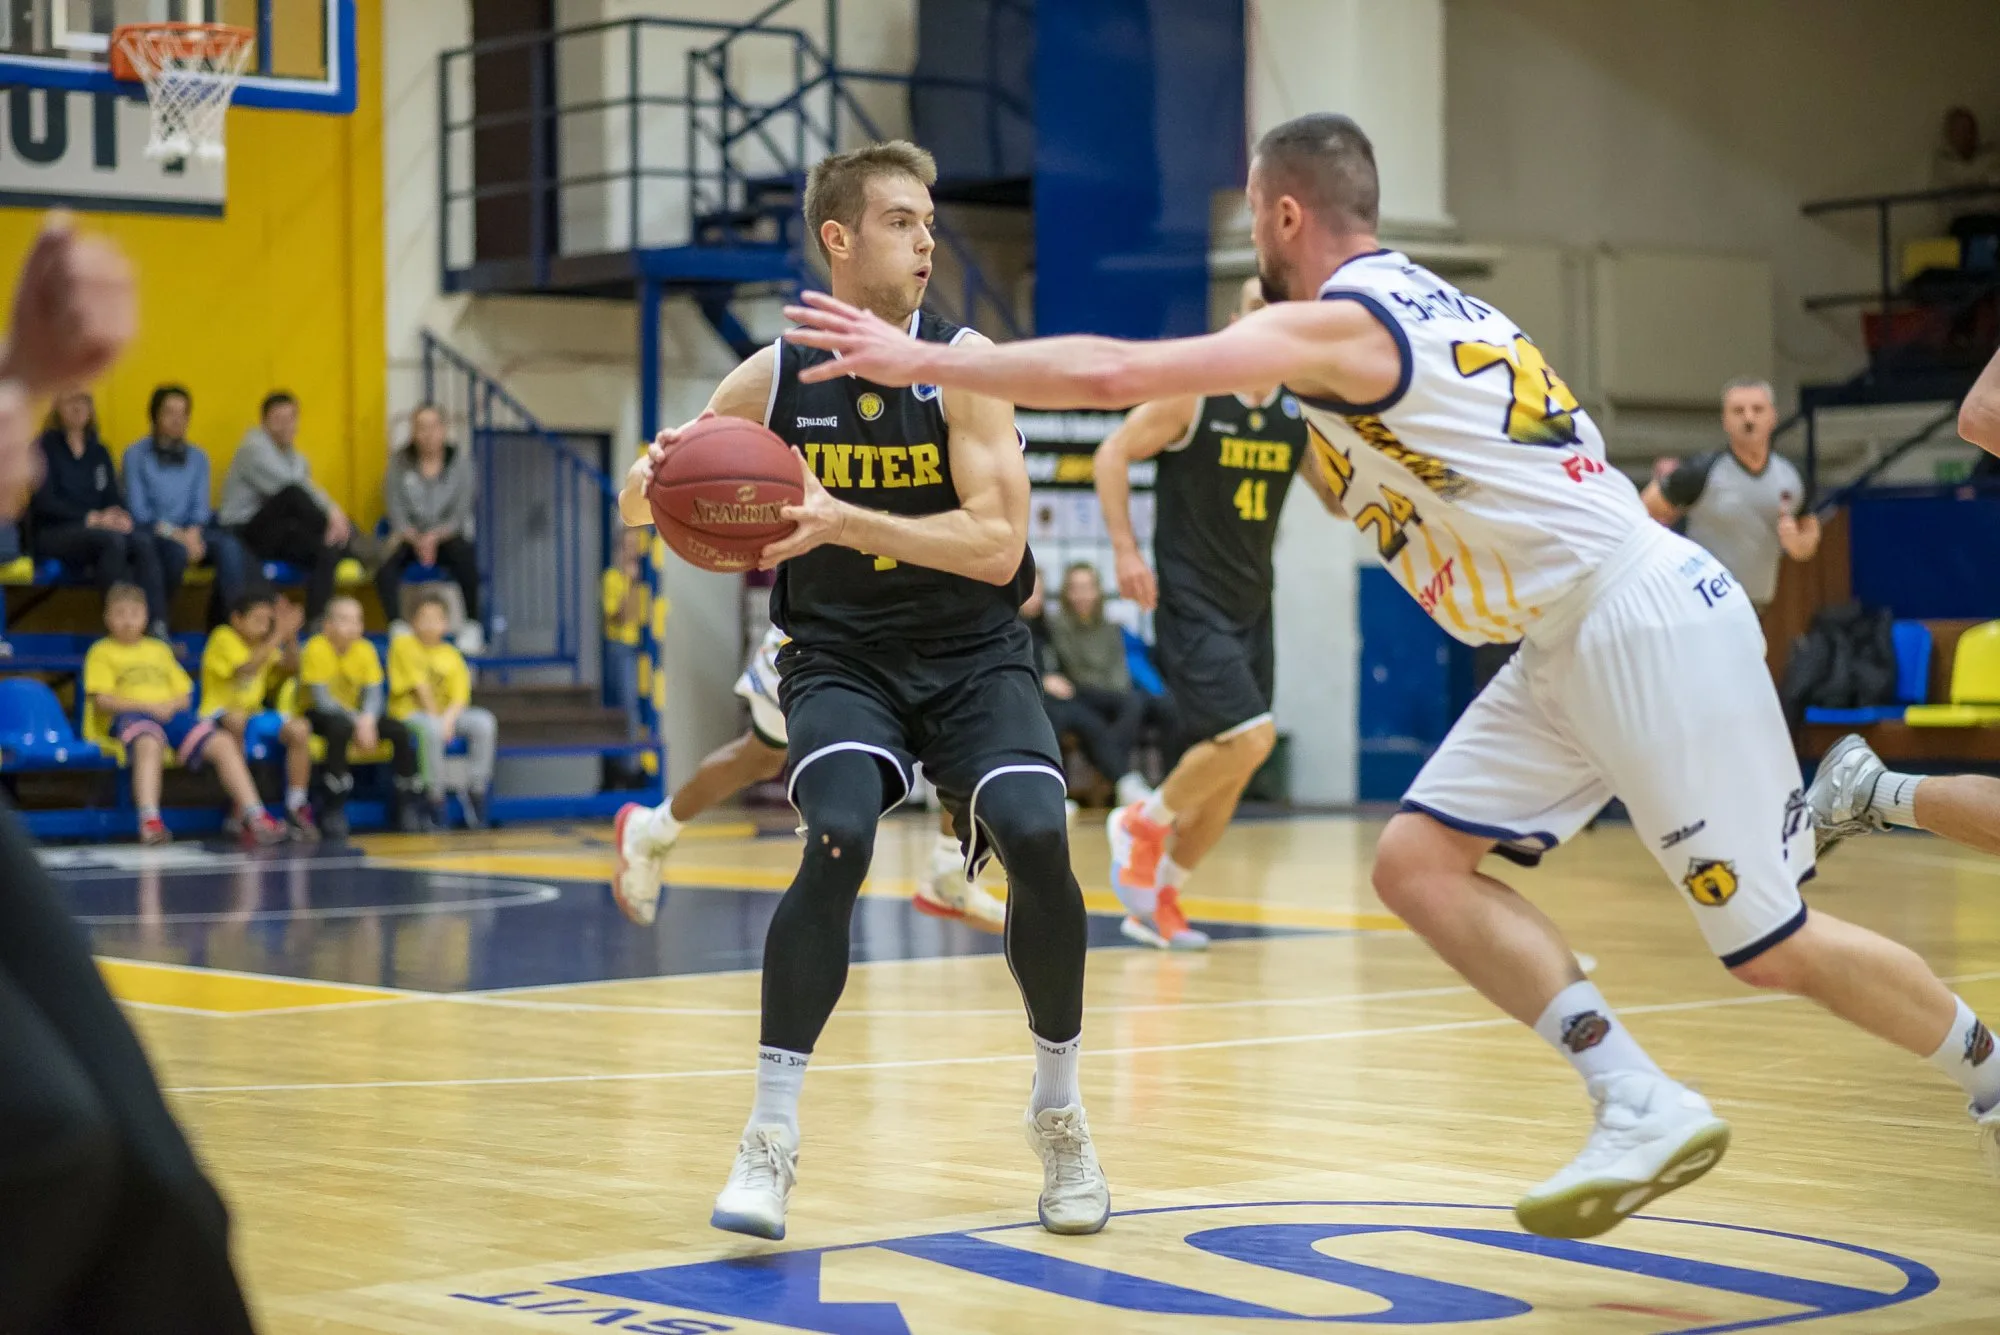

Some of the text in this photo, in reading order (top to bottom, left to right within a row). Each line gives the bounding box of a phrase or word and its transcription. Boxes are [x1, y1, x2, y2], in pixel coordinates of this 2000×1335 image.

[796, 415, 838, 428] SPALDING
[804, 442, 943, 489] INTER
[1218, 436, 1292, 472] INTER
[690, 497, 790, 526] SPALDIN
[1232, 477, 1268, 520] 41
[1353, 483, 1423, 561] 24
